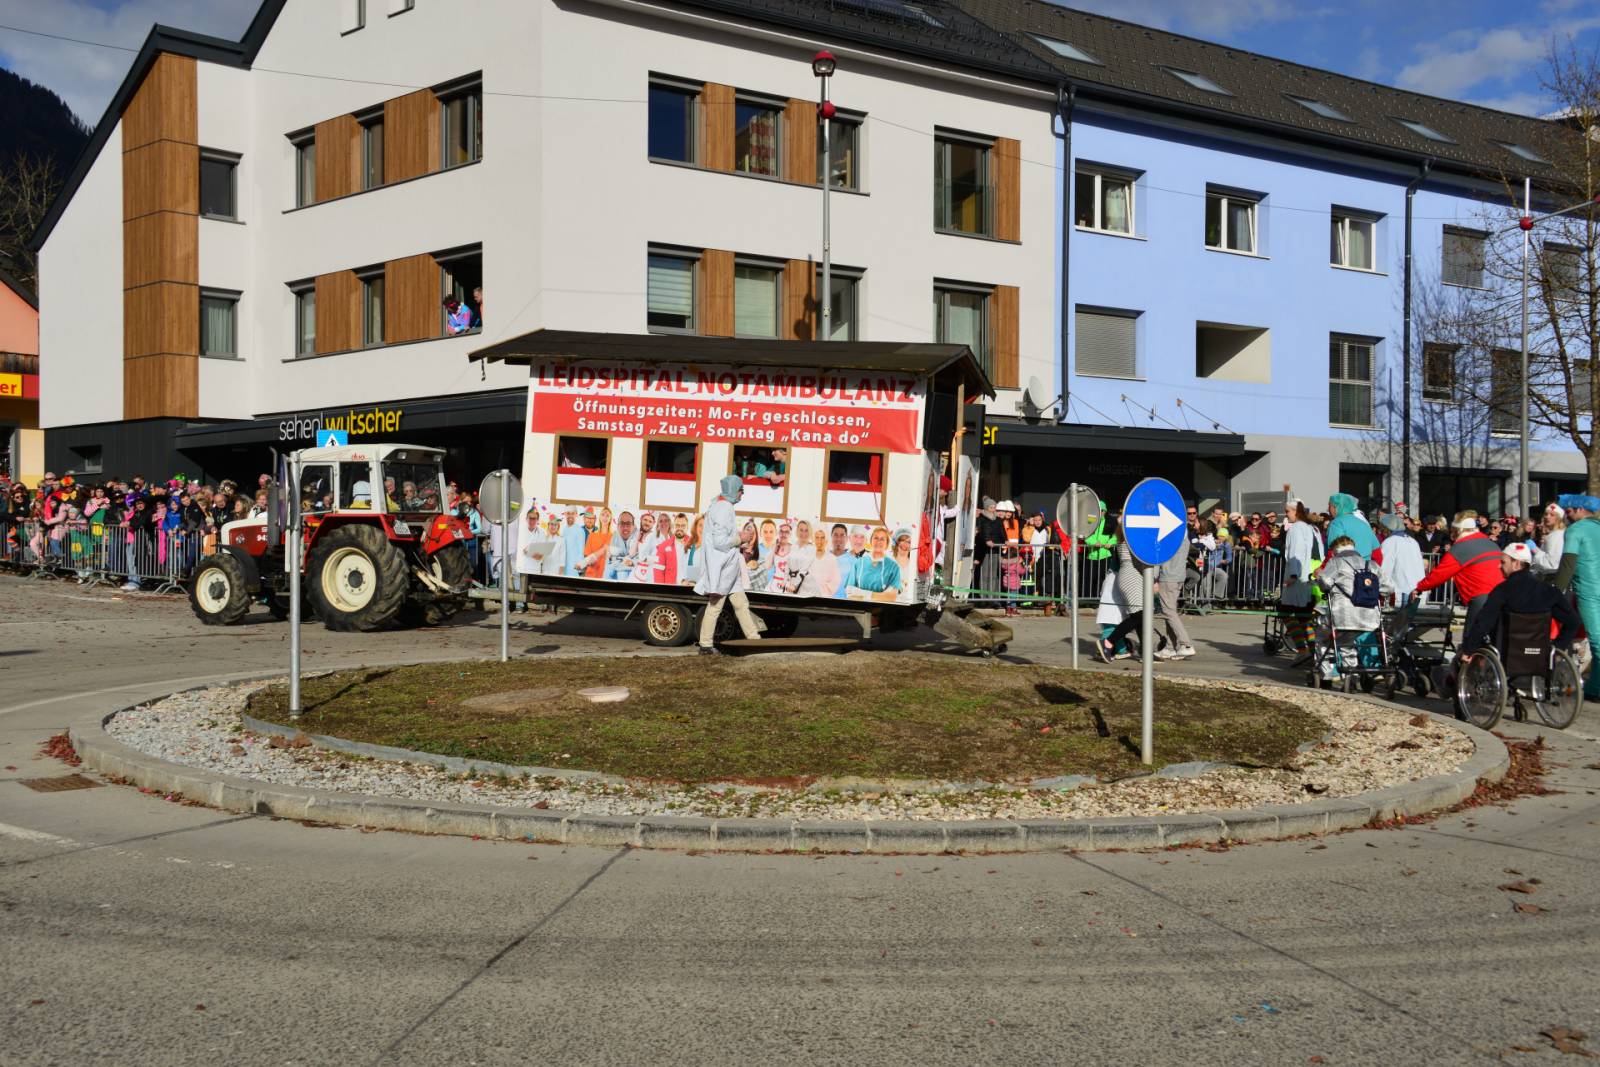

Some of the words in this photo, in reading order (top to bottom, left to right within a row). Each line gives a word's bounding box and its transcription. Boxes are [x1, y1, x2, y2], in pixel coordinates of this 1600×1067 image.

[538, 364, 689, 393] LEIDSPITAL
[697, 371, 916, 403] NOTAMBULANZ
[577, 417, 645, 436] Samstag
[707, 424, 776, 442] Sonntag
[708, 407, 757, 421] Mo-Fr
[762, 411, 872, 429] geschlossen,
